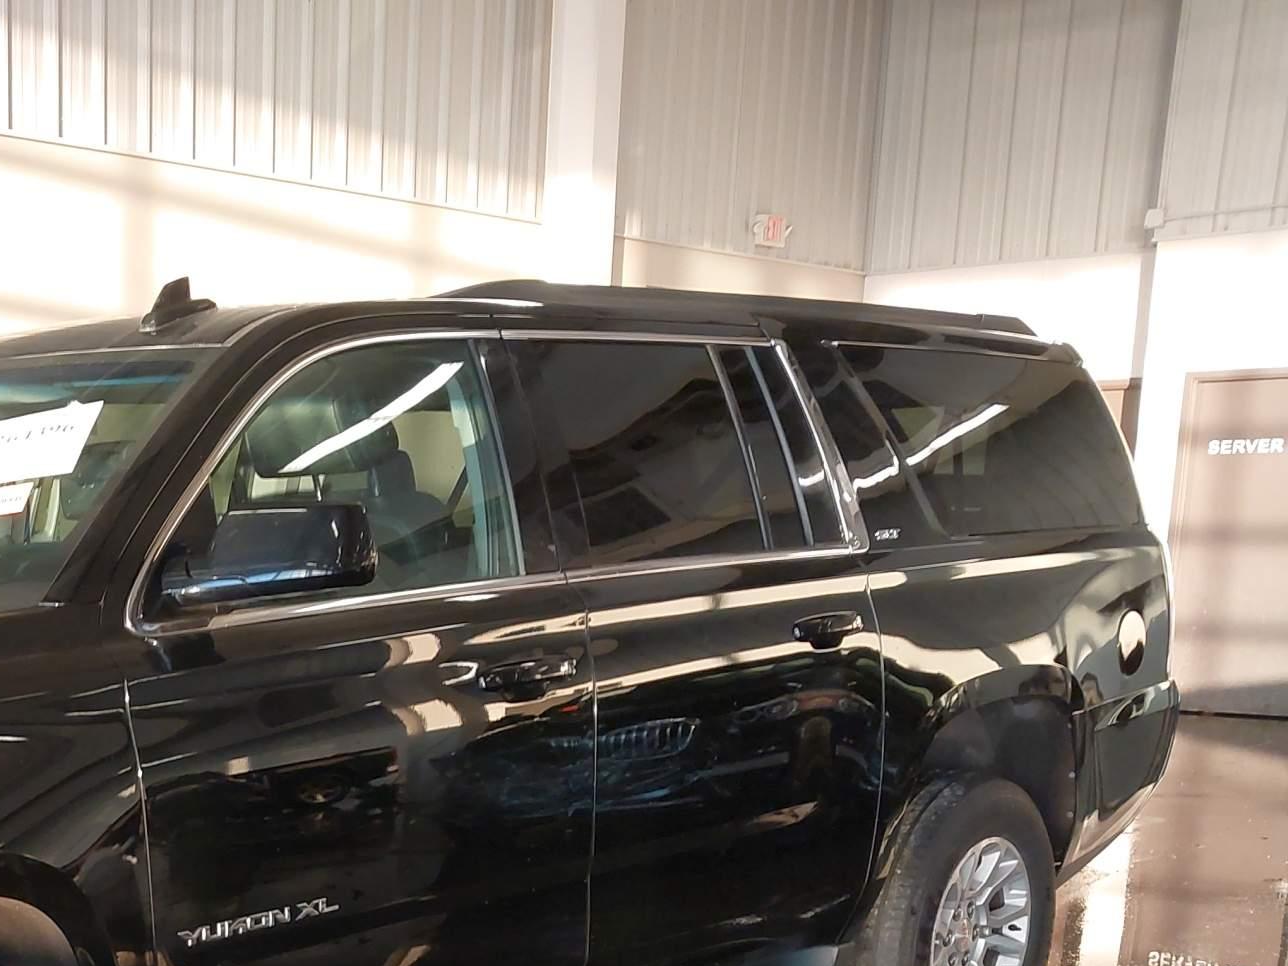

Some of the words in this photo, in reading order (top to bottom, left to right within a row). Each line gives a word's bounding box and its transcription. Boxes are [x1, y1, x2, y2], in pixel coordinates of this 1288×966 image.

[1207, 437, 1285, 455] SERVER
[177, 906, 291, 947] YUKON
[295, 897, 340, 921] XL
